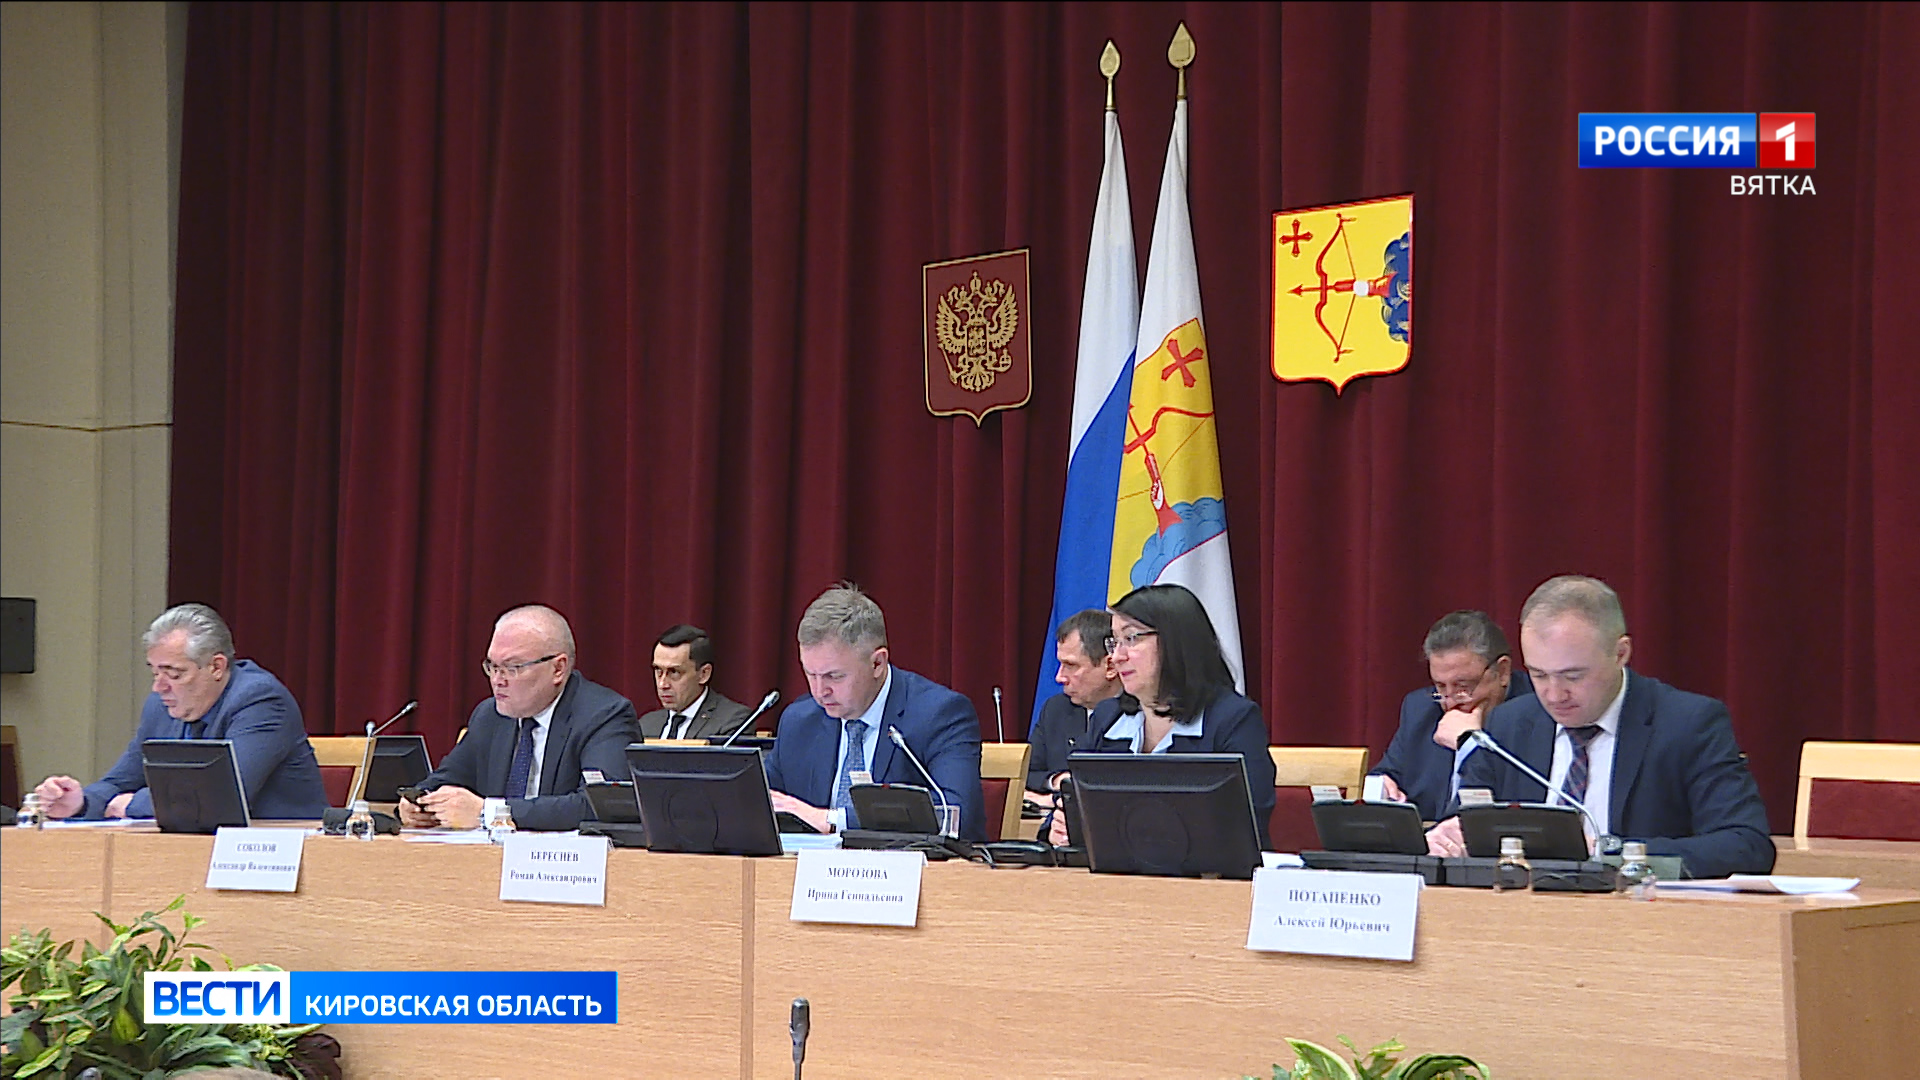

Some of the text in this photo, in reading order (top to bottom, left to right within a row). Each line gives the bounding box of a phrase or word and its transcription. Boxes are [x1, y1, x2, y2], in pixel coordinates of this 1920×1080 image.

[530, 850, 579, 862] БЕРЕСНЕВ
[510, 869, 598, 886] Роман Александрович
[827, 867, 888, 880] МОРОЗОВА
[807, 888, 904, 903] Ирина Геннадьевна
[1289, 889, 1382, 906] ПОТАПЕНКО
[1274, 915, 1391, 934] Алексей Юрьевич
